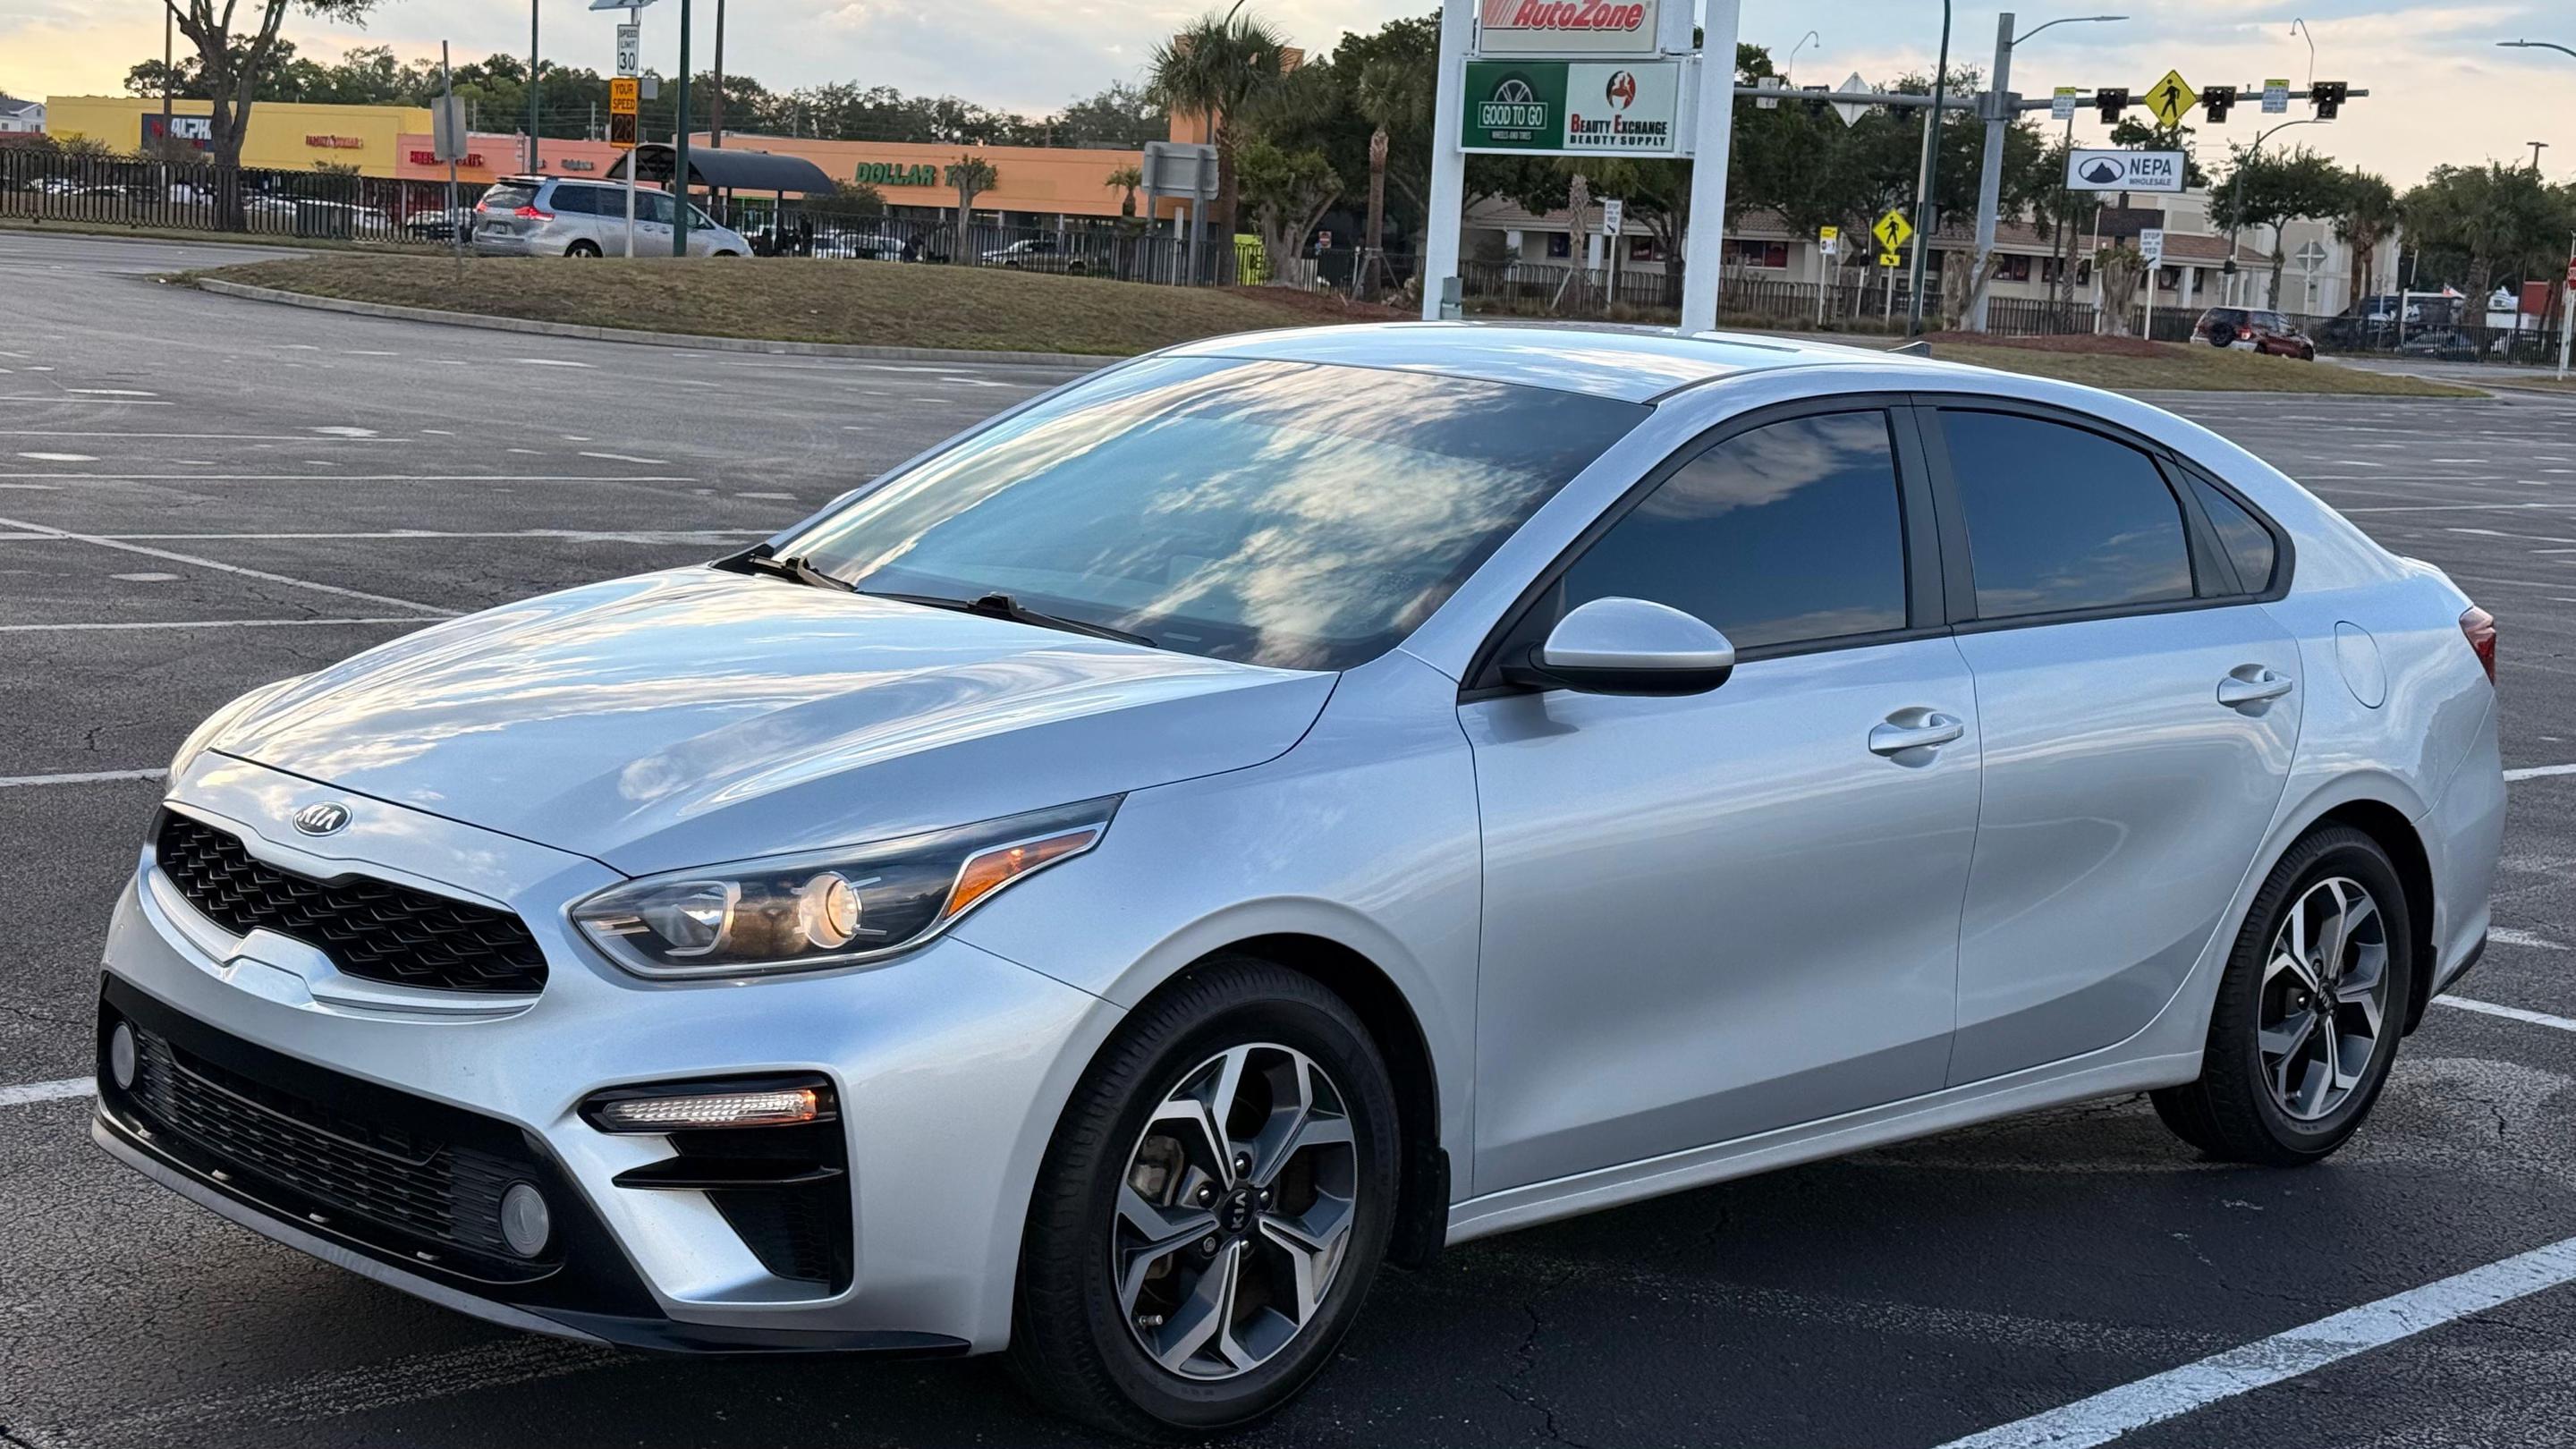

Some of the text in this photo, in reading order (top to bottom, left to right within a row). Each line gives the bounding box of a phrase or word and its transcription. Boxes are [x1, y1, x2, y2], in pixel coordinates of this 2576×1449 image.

[1513, 0, 1644, 29] AutoZone
[619, 30, 637, 38] SPEED
[619, 52, 635, 70] 30
[614, 83, 633, 94] YOUR
[613, 98, 635, 109] SPEED
[1483, 106, 1543, 125] GOOD TO GO
[1571, 114, 1667, 135] BEAUTY EXCHANGE
[171, 118, 213, 140] ALPH
[1570, 135, 1666, 147] BEAUTY SUPPLY
[856, 162, 936, 186] DOLLAR
[2130, 158, 2172, 175] NEPA
[2129, 178, 2172, 186] WHOLESALE
[298, 806, 341, 830] KIA
[1231, 1192, 1246, 1229] KIA
